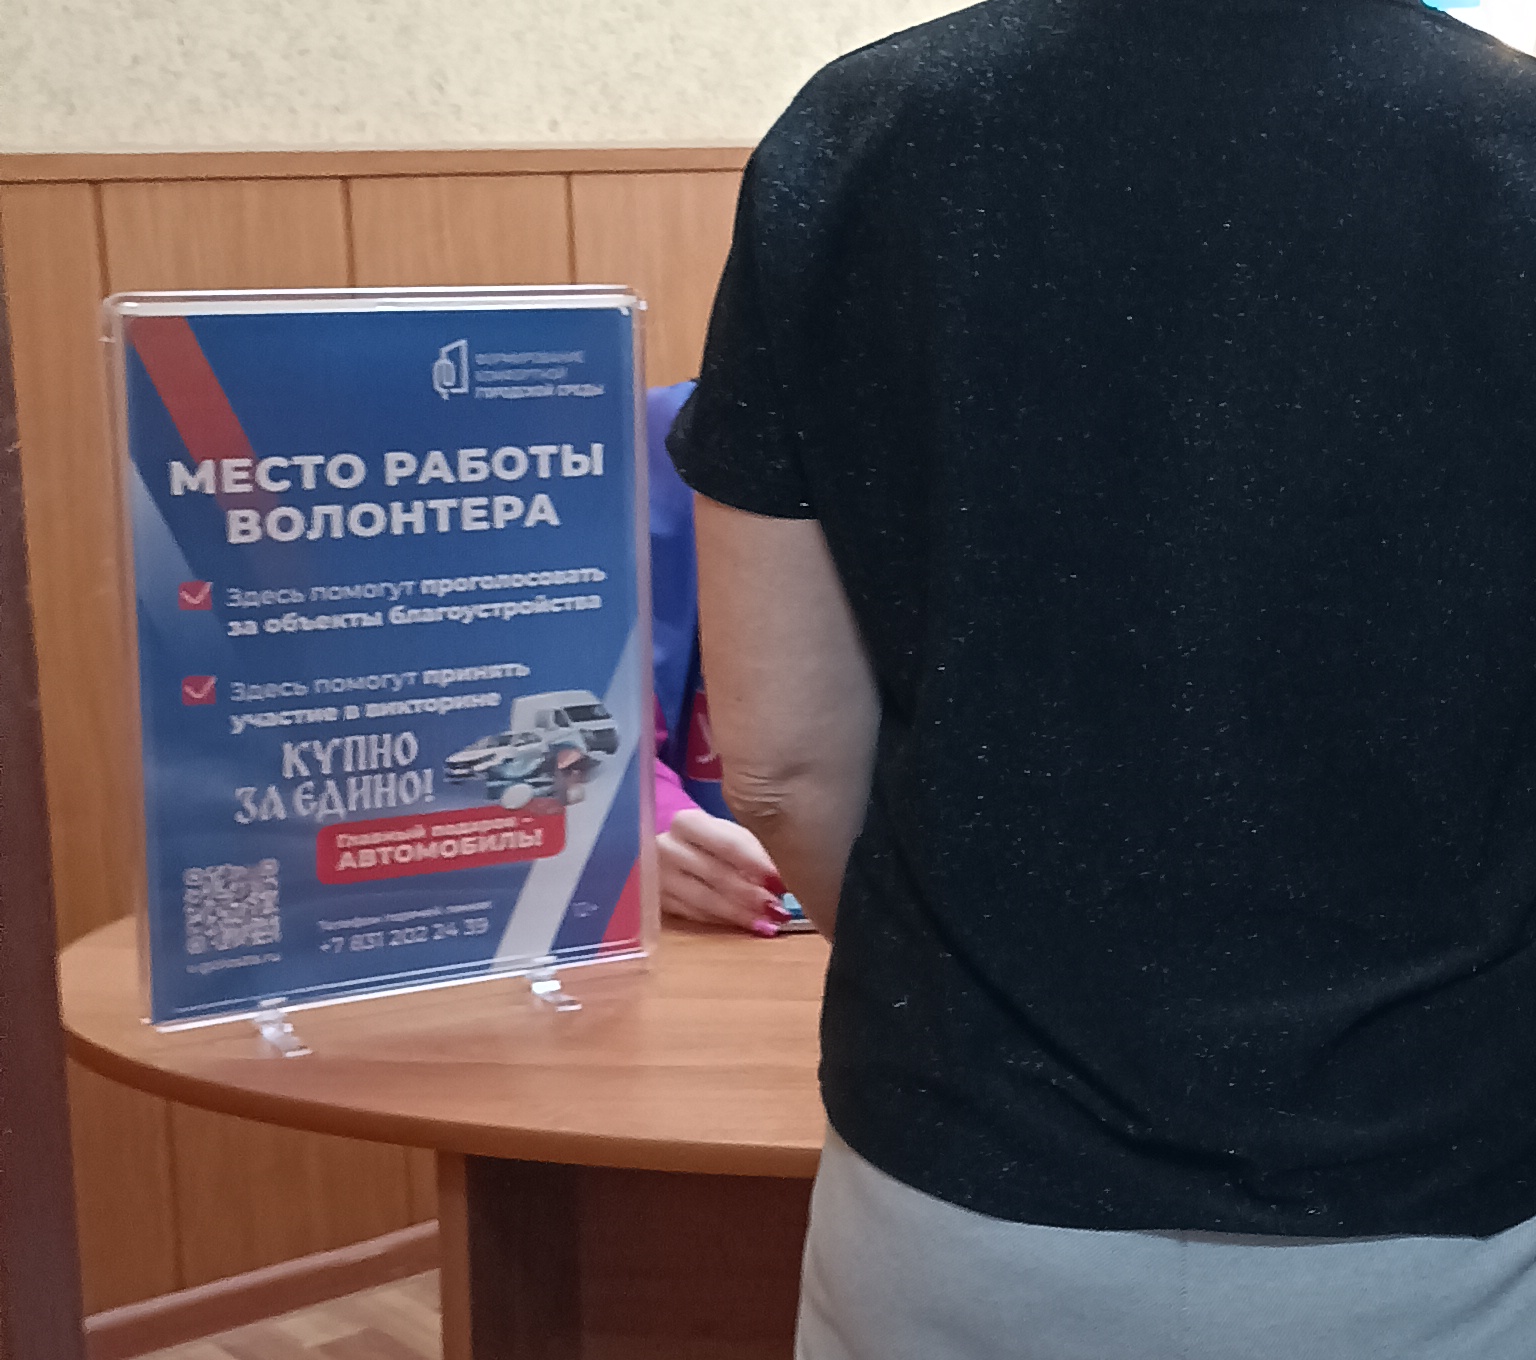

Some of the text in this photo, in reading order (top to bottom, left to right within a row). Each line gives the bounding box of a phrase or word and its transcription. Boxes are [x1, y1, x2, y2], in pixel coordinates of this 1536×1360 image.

[168, 443, 604, 496] МЕСТО РАБОТЫ
[226, 494, 561, 544] ВОЛОНТЕРА
[225, 588, 306, 608] Здесь
[309, 581, 415, 602] помогут
[312, 671, 419, 693] помогут
[281, 731, 419, 779] КУПНО
[234, 784, 287, 824] ЗА
